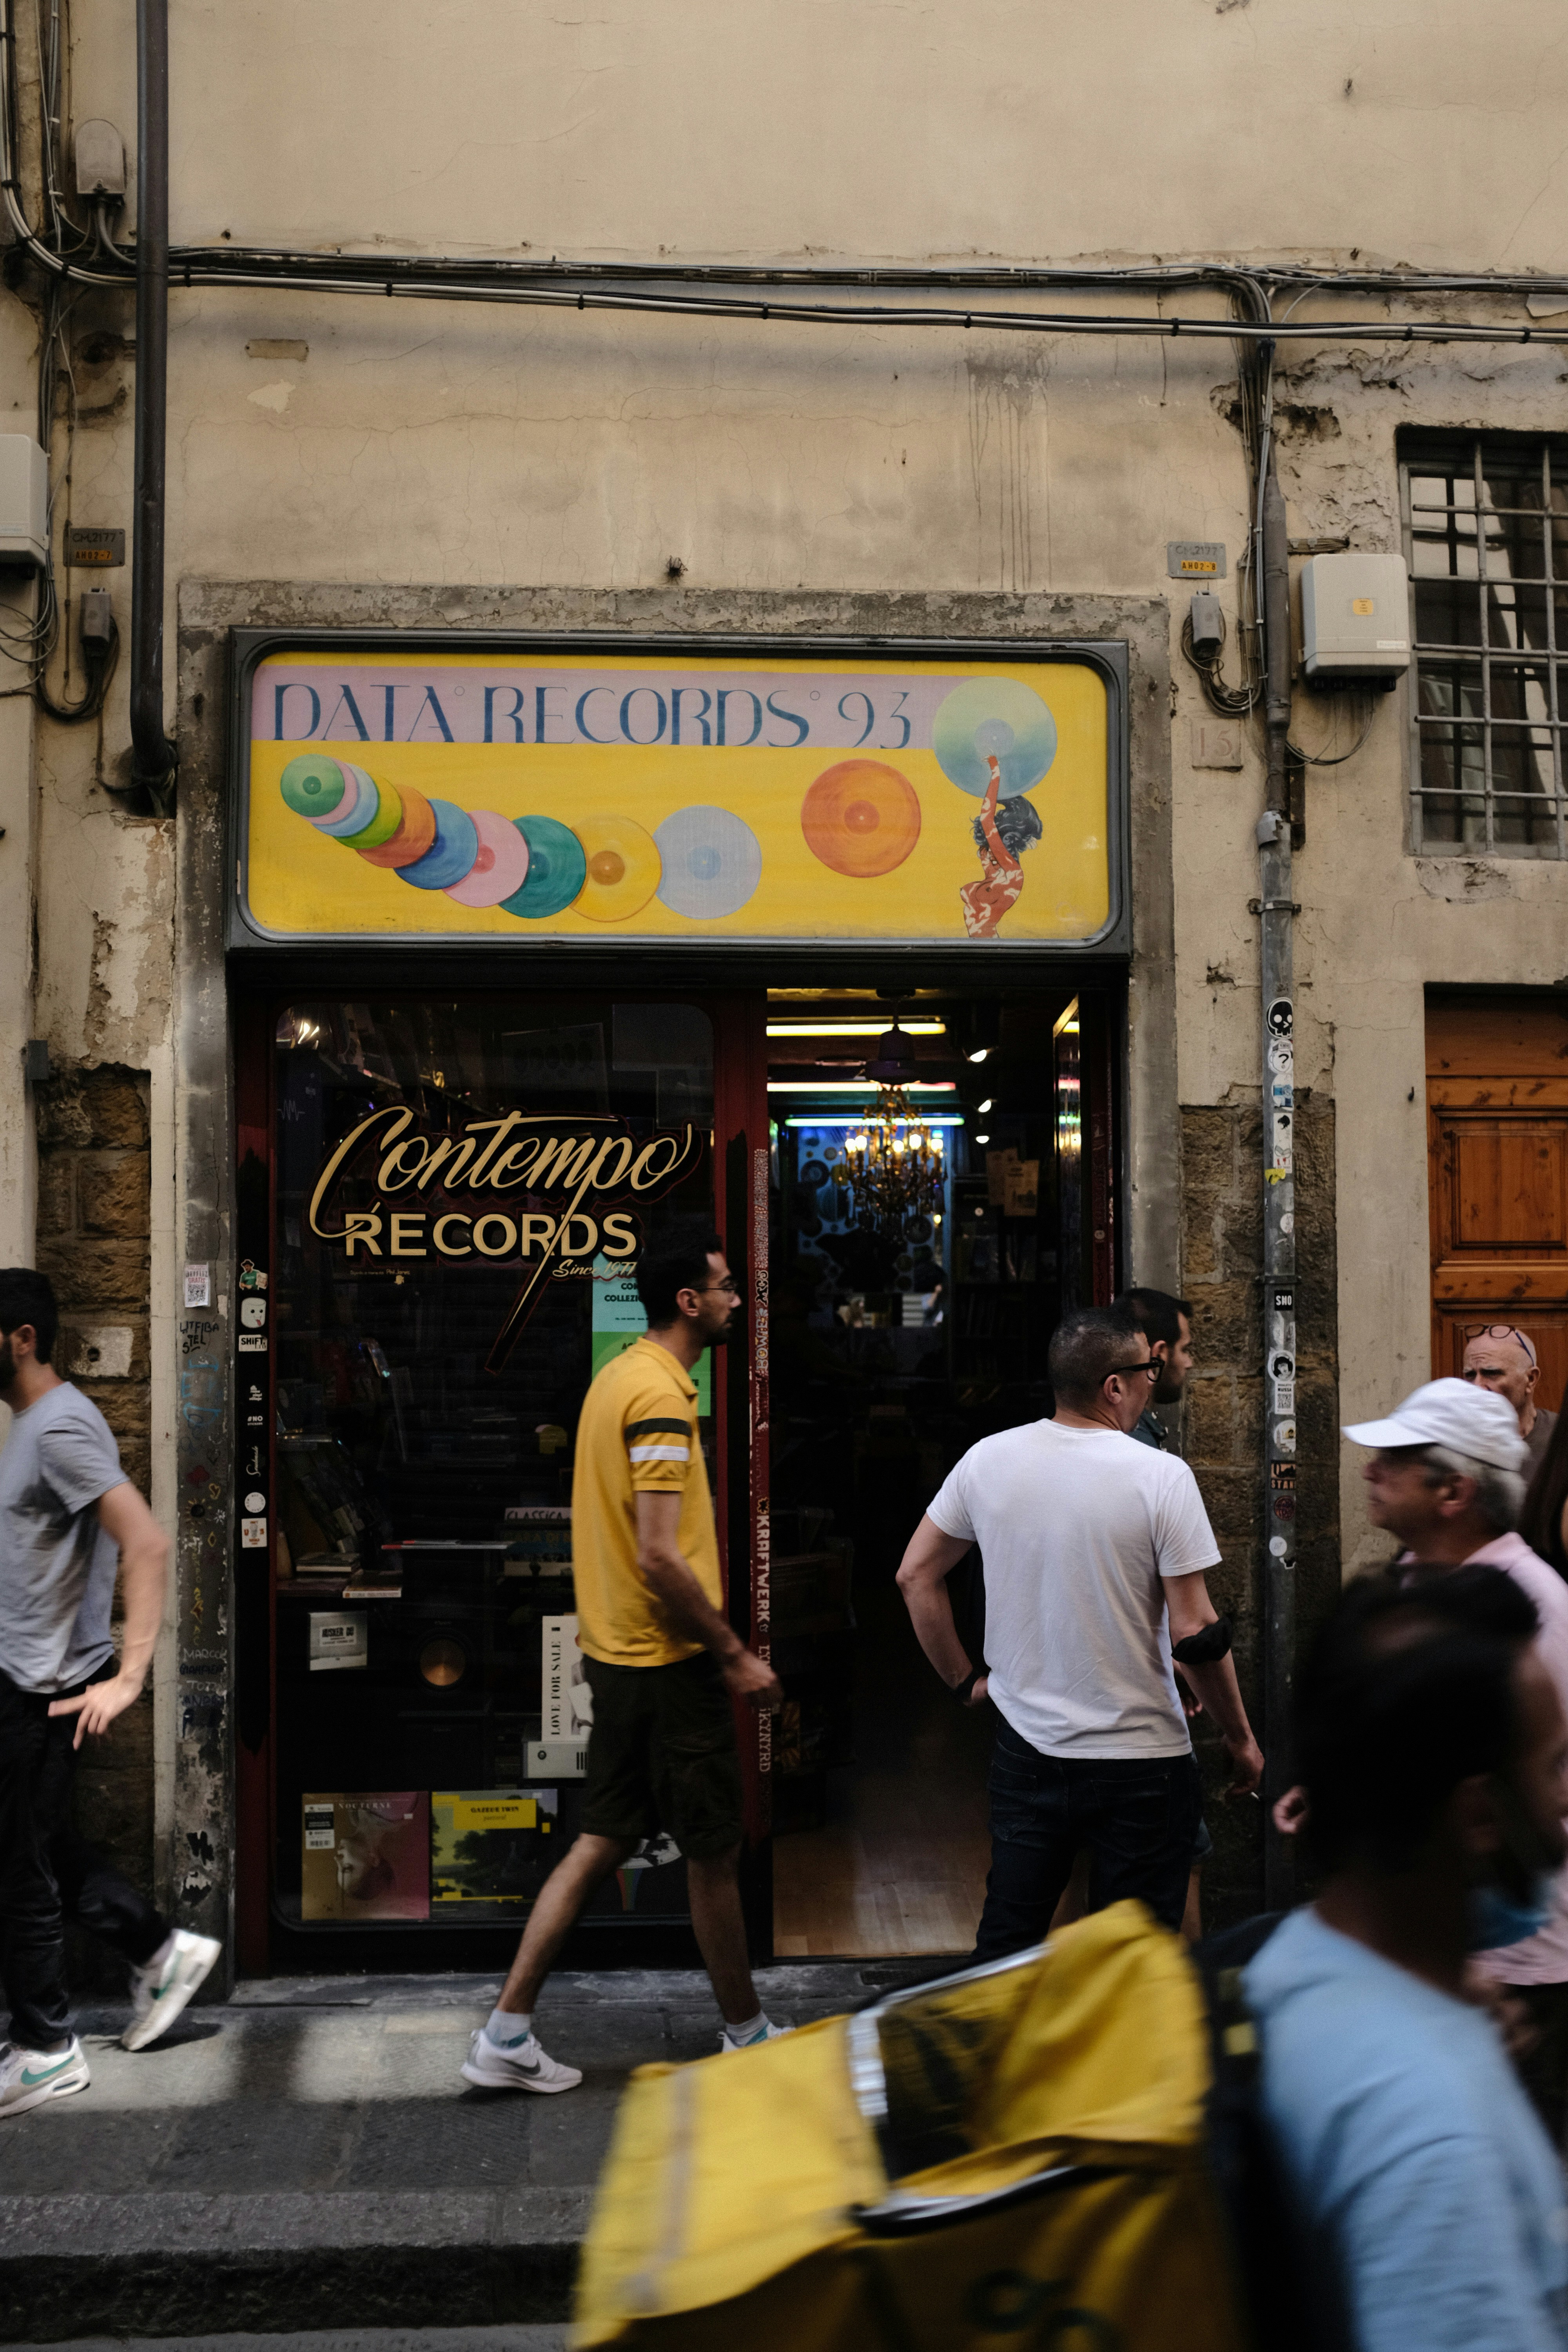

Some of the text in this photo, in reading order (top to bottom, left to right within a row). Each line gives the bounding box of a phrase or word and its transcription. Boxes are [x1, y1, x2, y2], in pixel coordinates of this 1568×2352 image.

[1182, 562, 1216, 571] AH02-8
[1199, 727, 1233, 758] 15
[309, 1105, 692, 1339] Contempo
[345, 1212, 637, 1256] RECORDS
[552, 1259, 637, 1278] Since 1977
[755, 1269, 769, 1307] MC5
[755, 1318, 769, 1372] BOWIE
[757, 1514, 770, 1623] KRAFTWERK
[550, 1641, 561, 1671] SALE
[550, 1676, 561, 1700] FOR
[550, 1704, 561, 1736] LOVE
